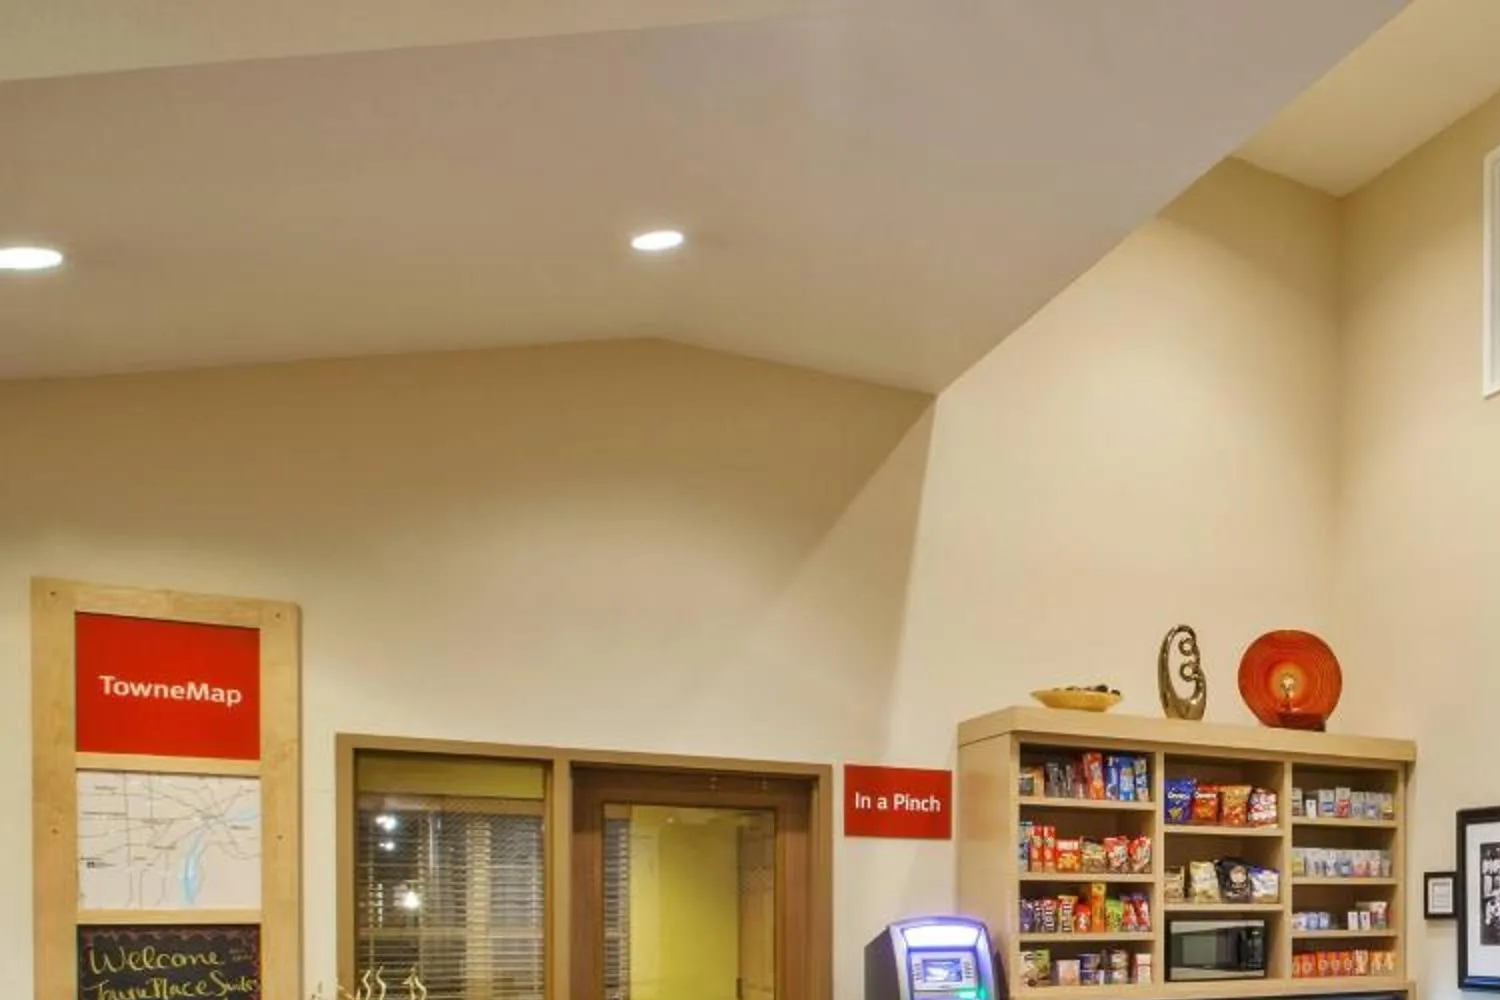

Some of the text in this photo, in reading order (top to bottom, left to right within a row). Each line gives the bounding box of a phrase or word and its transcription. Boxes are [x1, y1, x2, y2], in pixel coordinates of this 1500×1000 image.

[98, 675, 243, 708] TowneMap
[855, 791, 941, 812] In a Pinch
[89, 945, 225, 975] Welcome
